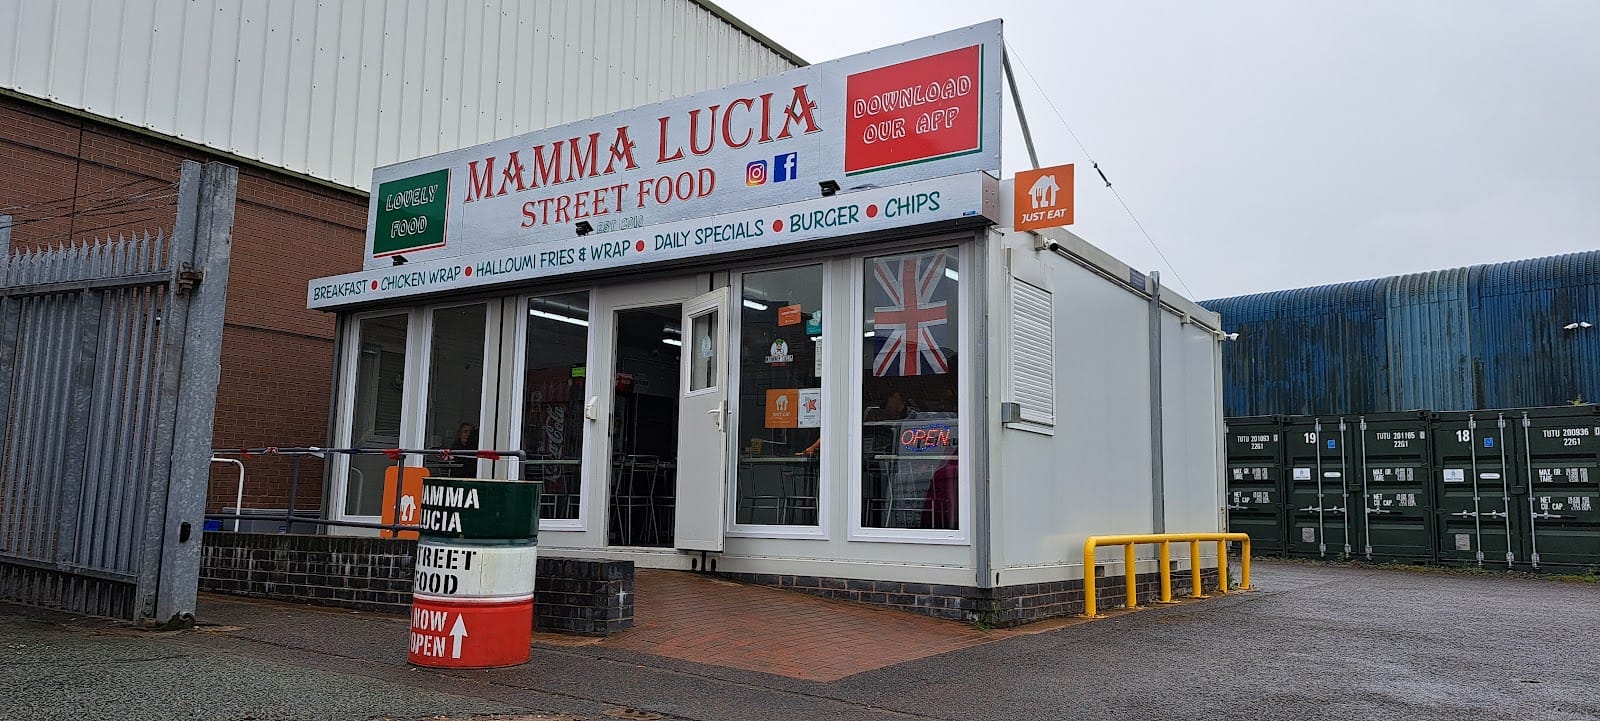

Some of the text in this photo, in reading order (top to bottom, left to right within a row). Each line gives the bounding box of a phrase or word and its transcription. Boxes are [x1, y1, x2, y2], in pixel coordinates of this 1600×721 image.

[853, 75, 971, 119] DOWNLOAD
[863, 106, 960, 144] OUR APP
[463, 84, 823, 204] MAMMA LUCIA
[385, 184, 438, 211] LOVELY
[520, 167, 716, 229] STREET FOOD
[390, 215, 428, 238] FOOD
[1021, 208, 1067, 224] JUST EAT
[313, 191, 941, 301] BREAKFAST CHICKEN WRAP HALLOUMI FRIES & WRAP DAILY SPECIALS BURGER CHIPS
[901, 429, 951, 446] OPEN
[1237, 435, 1250, 443] TUTU
[1303, 432, 1317, 444] 19
[1376, 432, 1391, 440] TUTU
[1393, 431, 1416, 440] 201165
[1456, 429, 1470, 442] 18
[1542, 429, 1560, 438] TUTU
[1562, 428, 1589, 437] 200936
[421, 484, 480, 509] AMMA
[416, 545, 477, 571] TREET
[412, 607, 448, 633] NOW
[410, 632, 446, 658] OPEN
